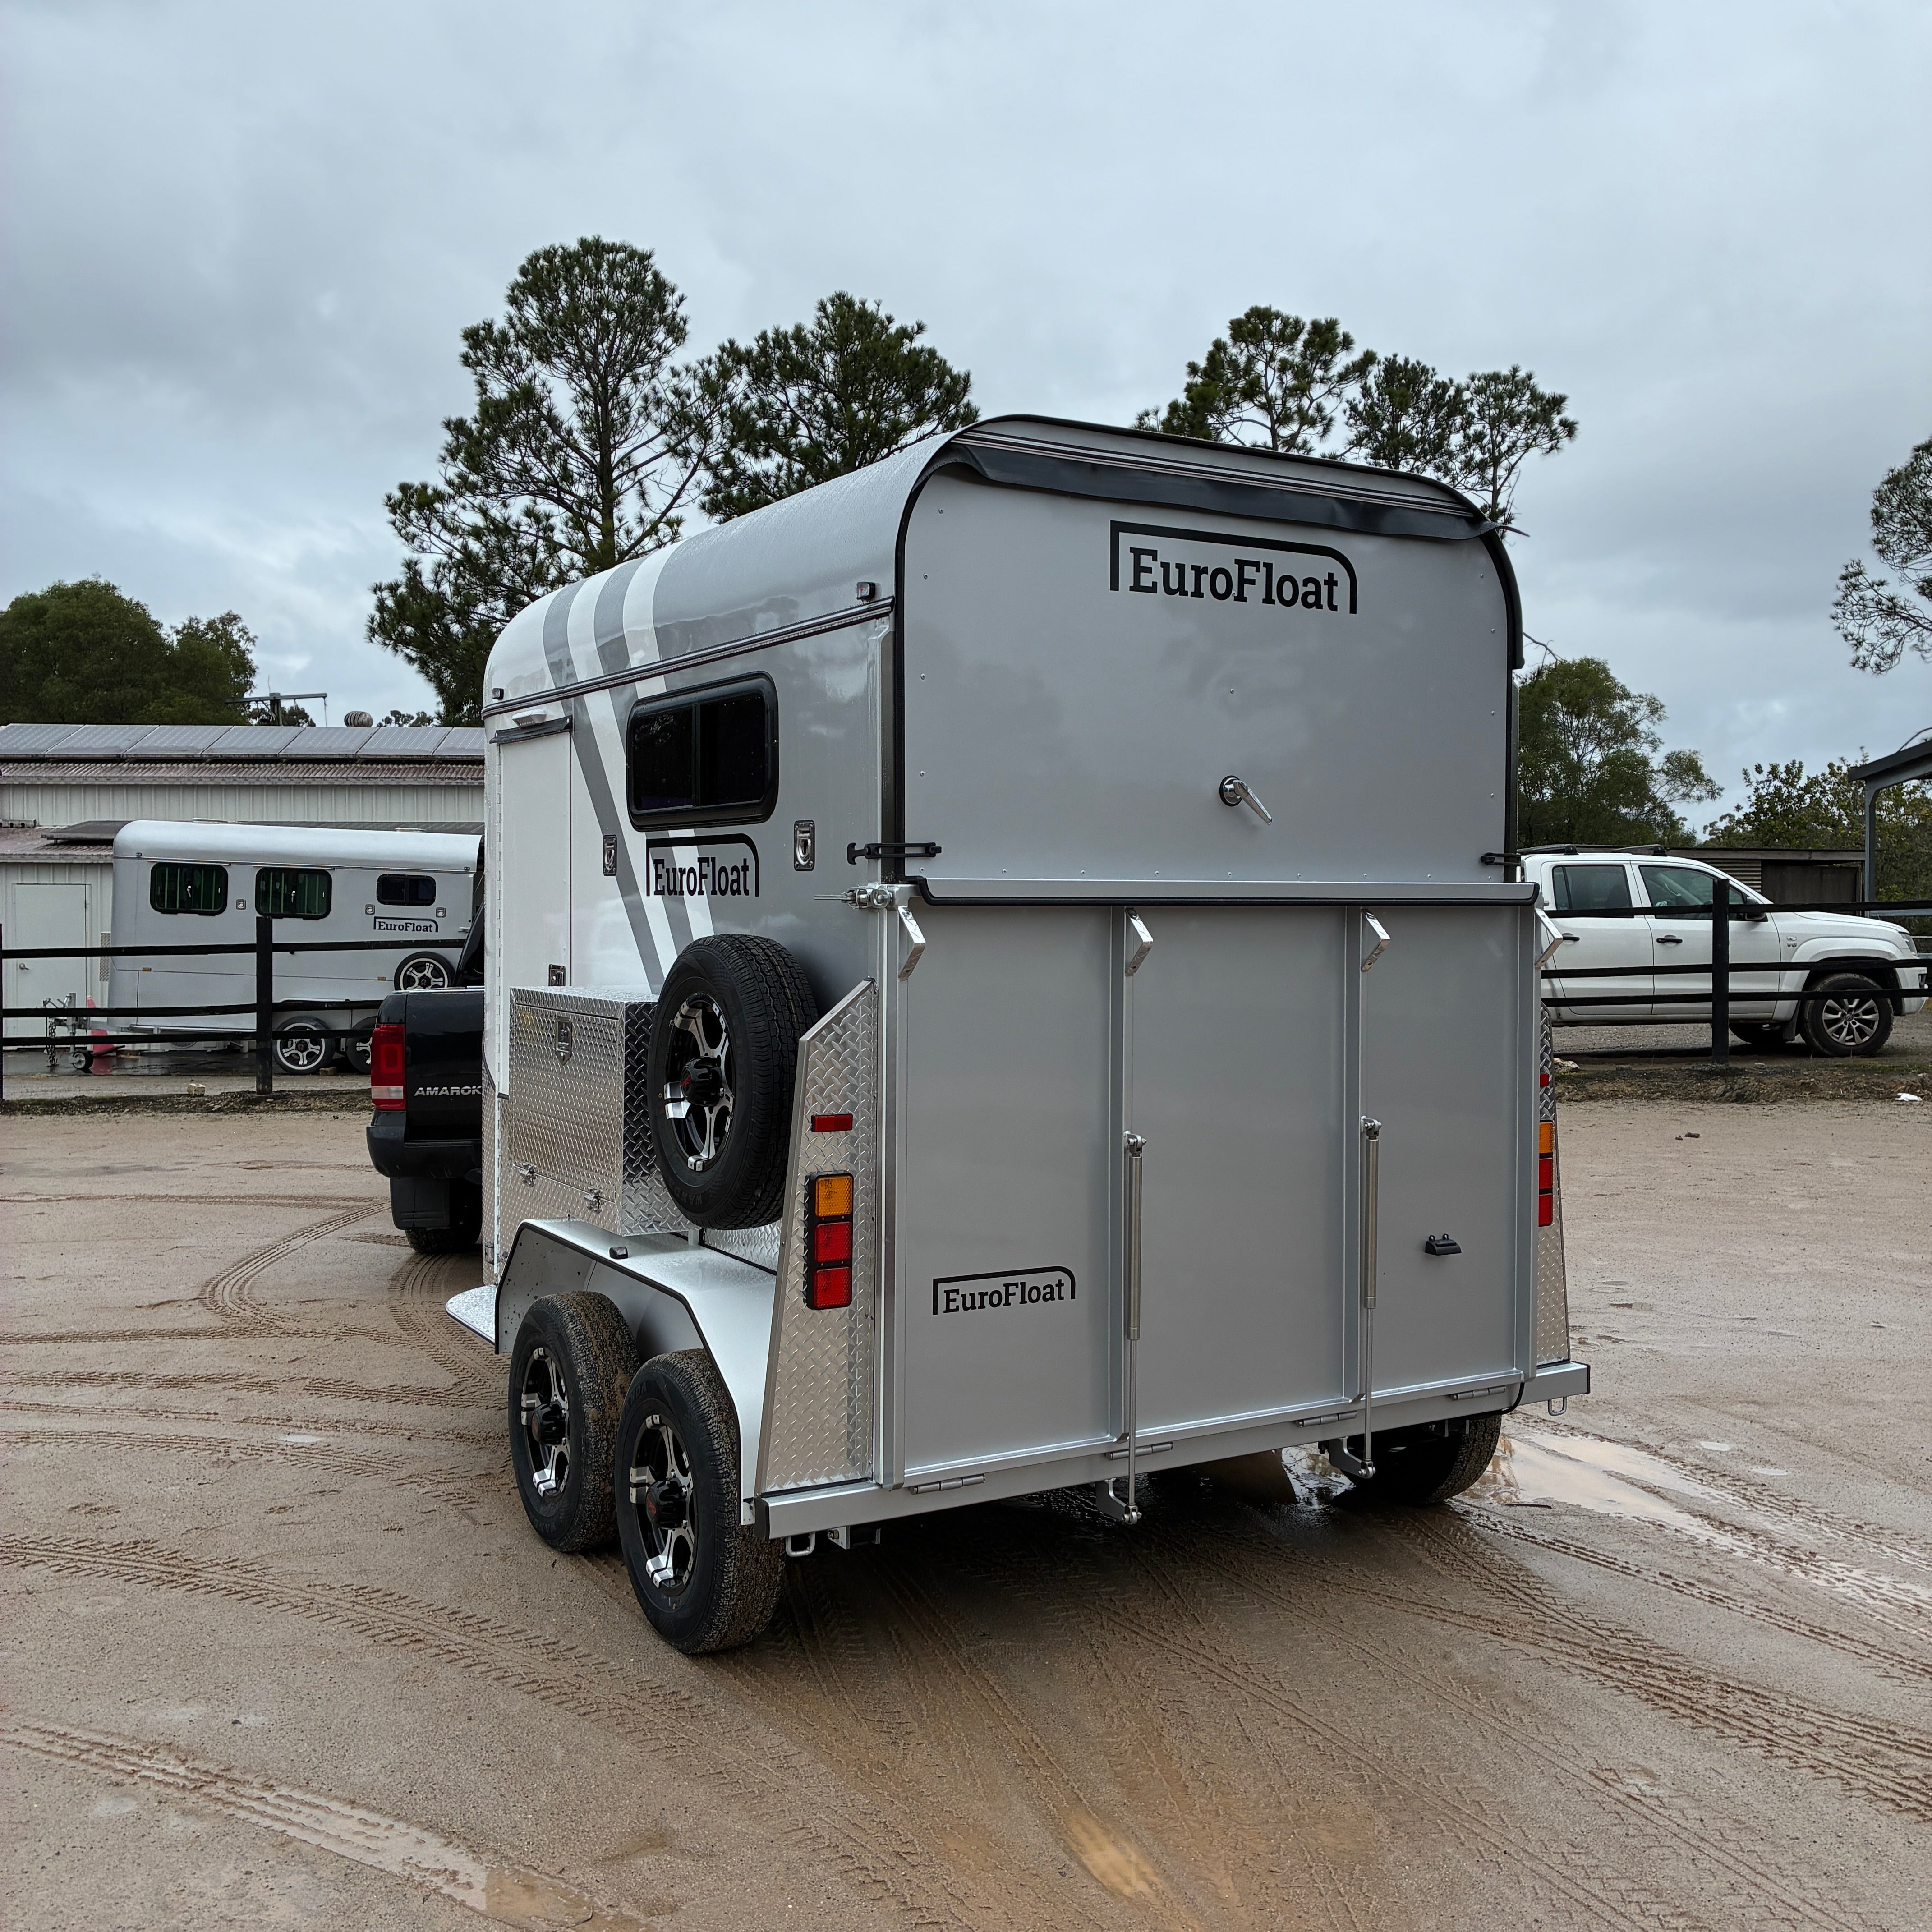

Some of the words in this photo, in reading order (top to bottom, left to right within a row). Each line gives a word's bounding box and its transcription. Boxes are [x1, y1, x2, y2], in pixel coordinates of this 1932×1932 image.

[1129, 547, 1338, 611] EuroFloat
[653, 856, 749, 896] EuroFloat
[377, 921, 433, 932] EuroFloat
[414, 1086, 482, 1096] AMAROK
[943, 1279, 1064, 1313] EuroFloat
